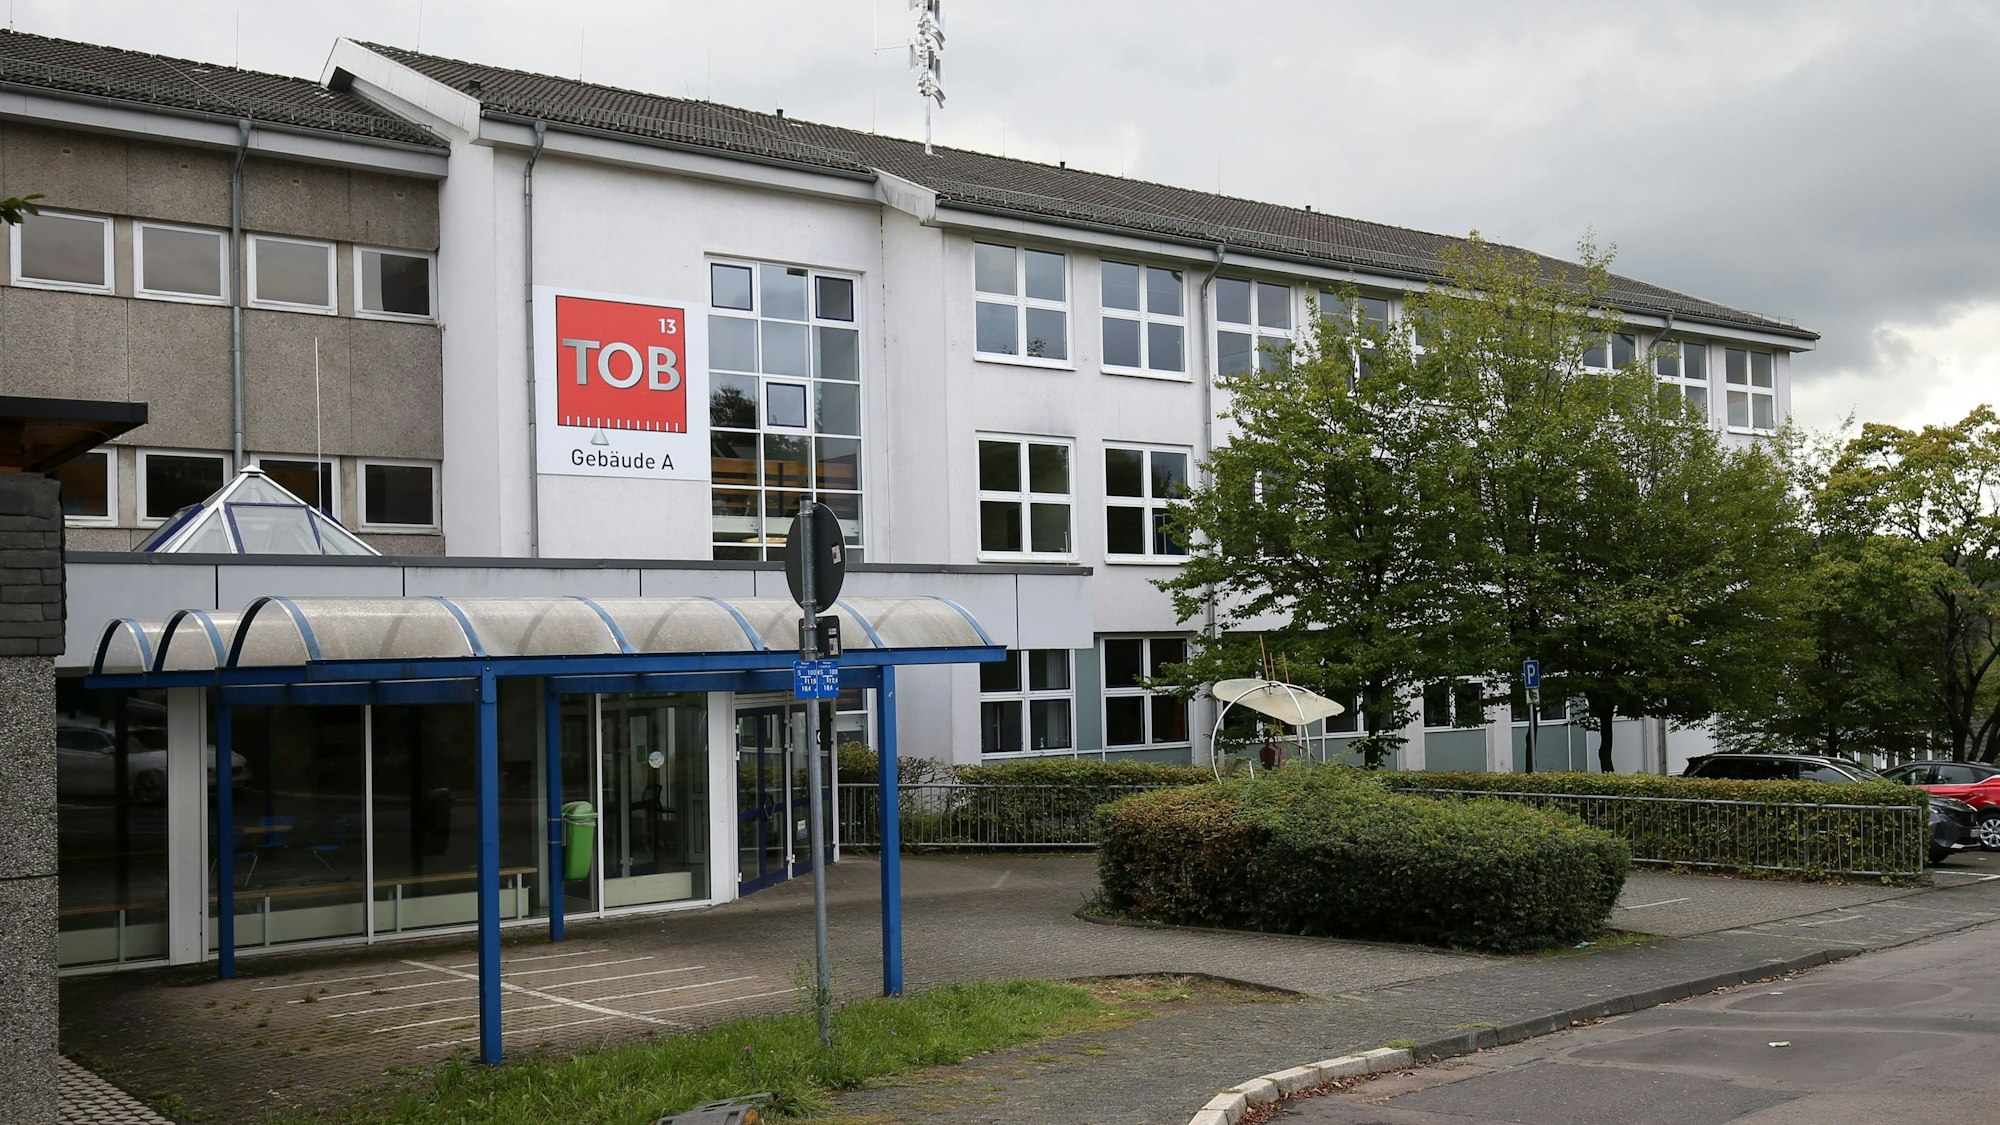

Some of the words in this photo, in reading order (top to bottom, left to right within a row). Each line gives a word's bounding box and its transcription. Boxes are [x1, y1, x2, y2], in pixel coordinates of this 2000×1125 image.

[658, 318, 677, 334] 13
[562, 338, 681, 391] TOB
[571, 448, 655, 469] Gebäude
[661, 454, 674, 470] A
[1527, 664, 1536, 684] P
